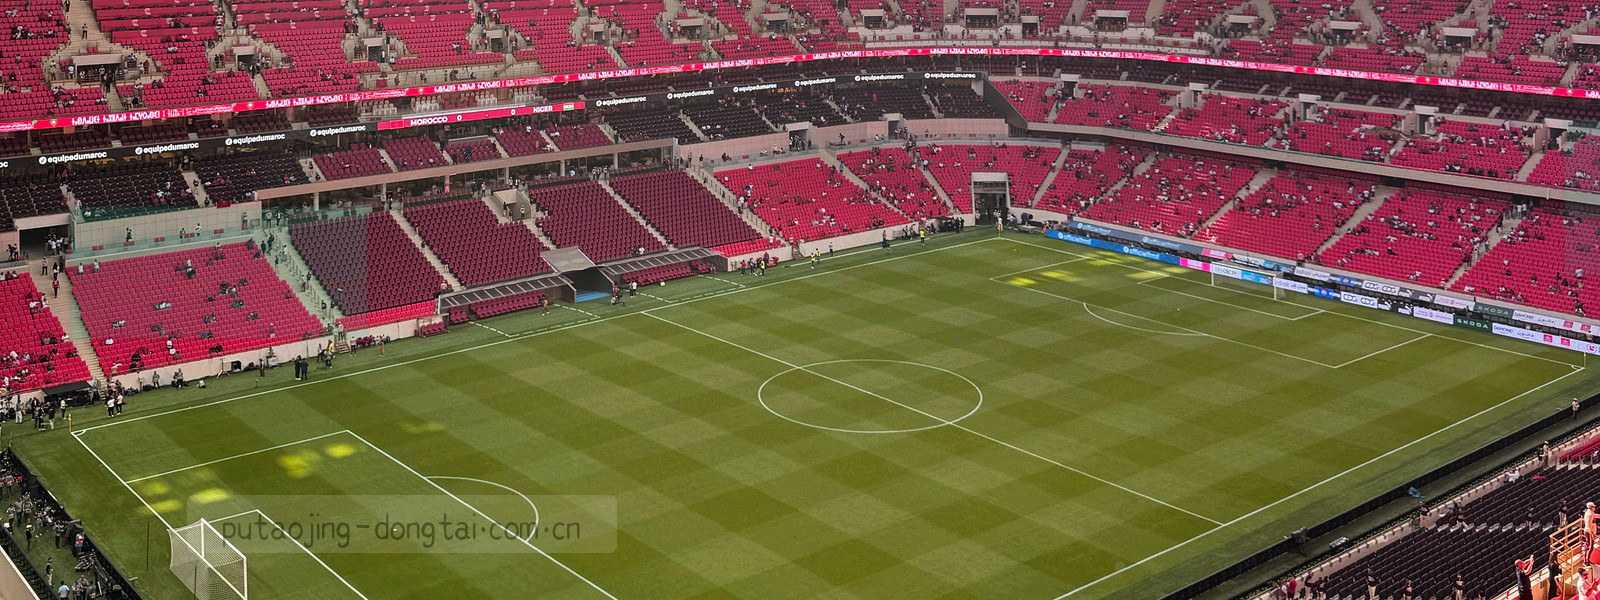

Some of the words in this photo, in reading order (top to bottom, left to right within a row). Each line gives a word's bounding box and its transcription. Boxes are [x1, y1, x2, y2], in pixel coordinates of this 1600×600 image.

[410, 116, 448, 127] MOROCCO
[456, 114, 463, 122] 0
[533, 105, 553, 113] NIGER
[317, 124, 367, 136] equipedumaroc
[233, 133, 285, 145] equipedumaroc
[143, 141, 199, 154] equipedumaroc
[47, 151, 107, 164] equipedumaroc
